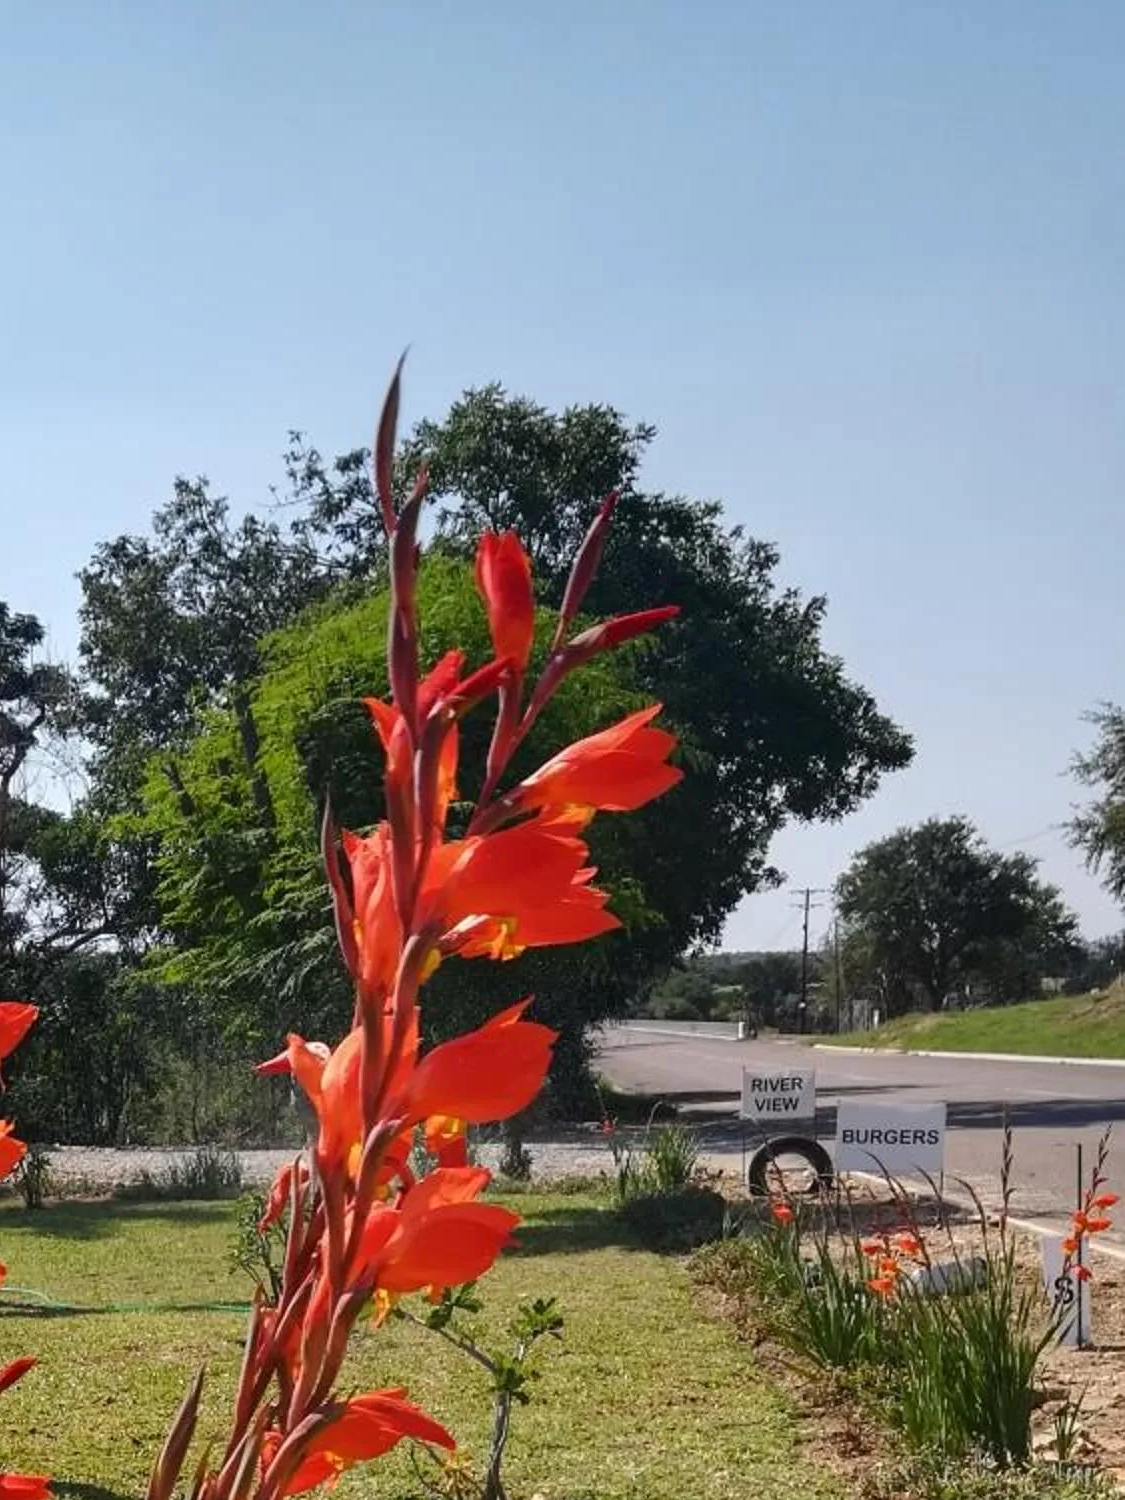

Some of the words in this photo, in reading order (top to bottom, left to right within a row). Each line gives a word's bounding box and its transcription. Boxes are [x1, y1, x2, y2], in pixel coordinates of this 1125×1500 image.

[750, 1077, 804, 1093] RIVER
[754, 1097, 801, 1113] VIEW
[841, 1129, 940, 1146] BURGERS
